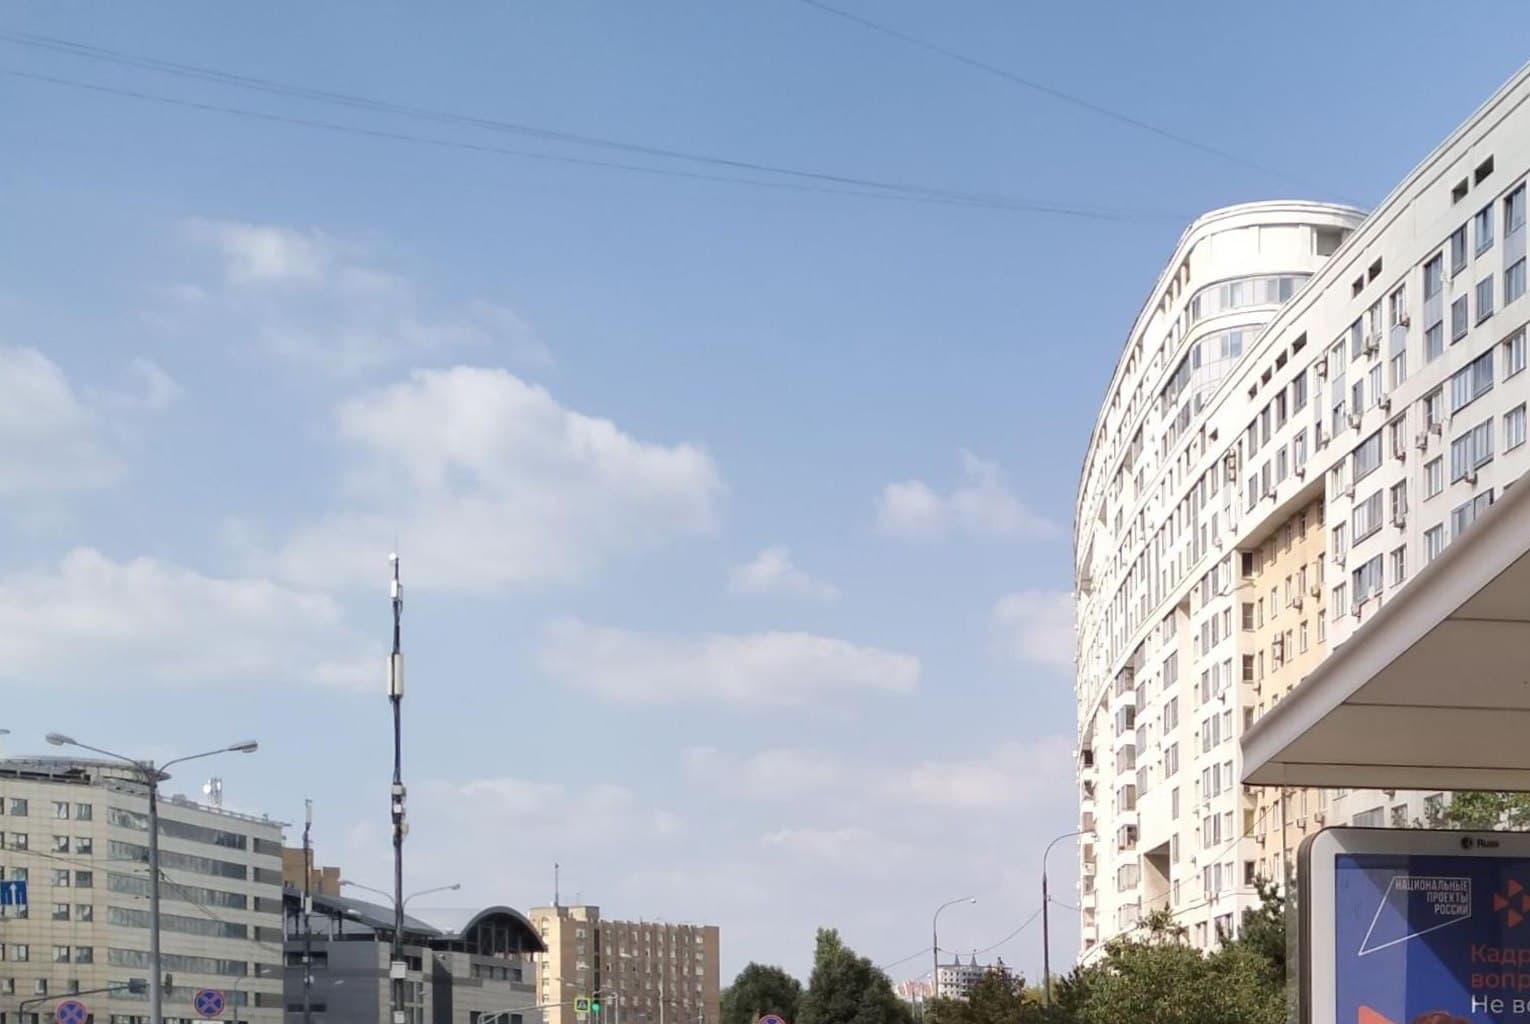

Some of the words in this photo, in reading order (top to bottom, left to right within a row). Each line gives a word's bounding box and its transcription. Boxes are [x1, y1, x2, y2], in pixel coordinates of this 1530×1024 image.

[1395, 879, 1469, 891] НАЦИОНАЛЬНЫЕ
[1426, 891, 1468, 903] ПРОЕКТЫ
[1434, 903, 1468, 915] РОССИИ
[1471, 995, 1505, 1013] Не
